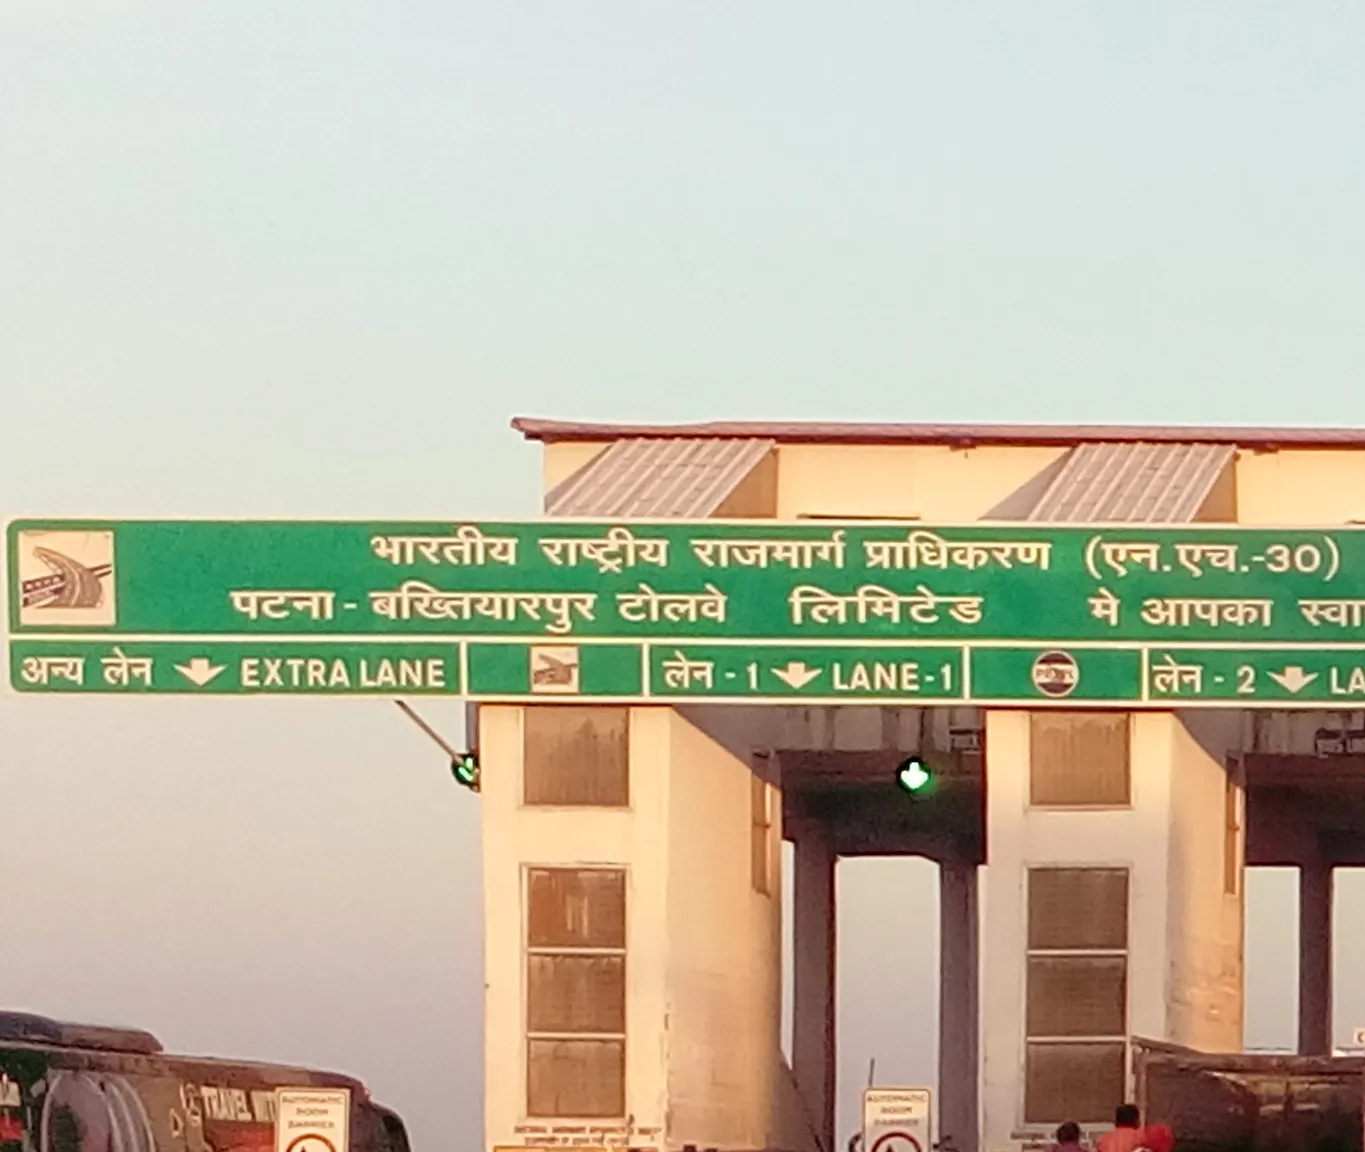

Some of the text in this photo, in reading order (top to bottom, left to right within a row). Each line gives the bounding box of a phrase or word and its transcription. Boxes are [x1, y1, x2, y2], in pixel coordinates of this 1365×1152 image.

[371, 527, 518, 566] भारतीय
[538, 528, 669, 573] राष्ट्रीय
[691, 530, 846, 569] राजमार्ग
[864, 530, 1053, 570] प्राधिकरण
[230, 591, 335, 620] पटना
[369, 583, 598, 634] बख्तियारपुर
[616, 583, 728, 623] टोलवे
[788, 585, 984, 625] लिमिटेड
[1141, 599, 1273, 627] आपका
[21, 650, 153, 688] अन्य लेन
[240, 658, 446, 689] EXTRA LANE
[662, 653, 714, 690] लेन
[1152, 659, 1203, 694] लेन
